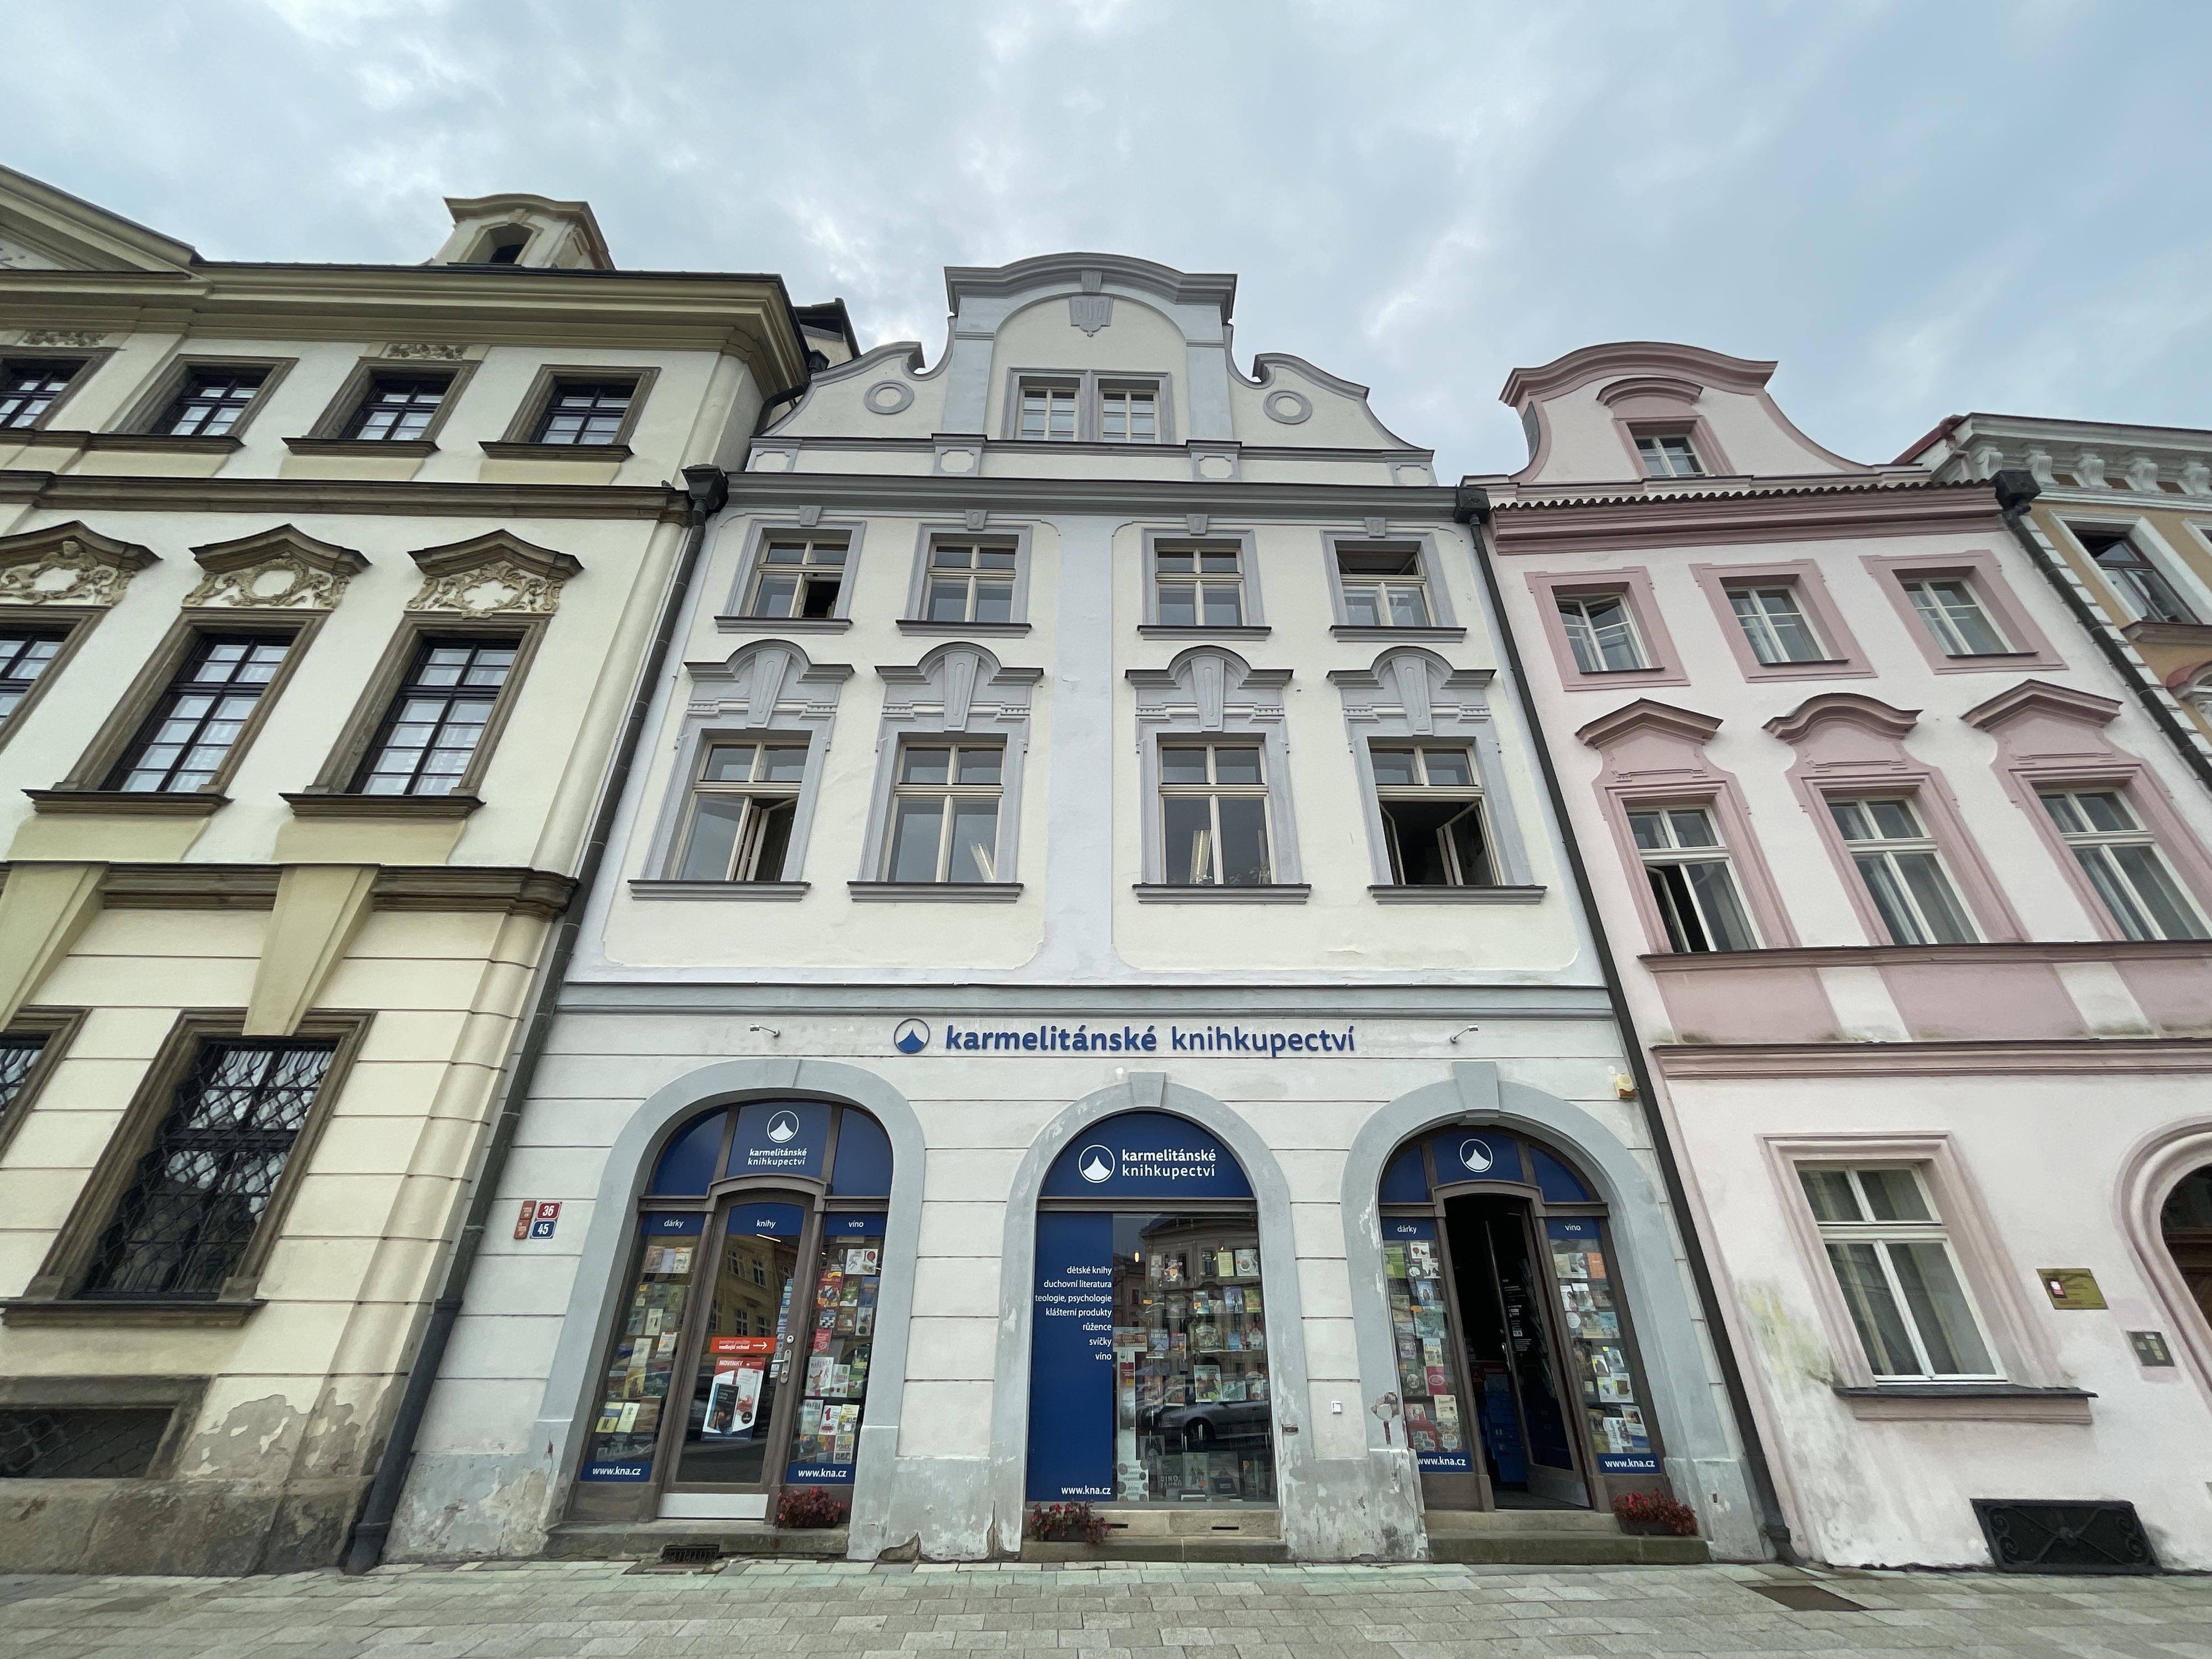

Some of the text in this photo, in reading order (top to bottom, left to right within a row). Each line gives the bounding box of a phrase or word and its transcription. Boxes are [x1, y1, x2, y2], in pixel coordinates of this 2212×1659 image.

[946, 1025, 1354, 1057] karmelitánské knihkupectví
[750, 1147, 806, 1156] karmelitánské
[1123, 1149, 1215, 1161] karmelitánské
[748, 1157, 805, 1167] knihkupectví
[1123, 1164, 1214, 1180] knihkupectví
[542, 1206, 554, 1216] 36
[665, 1220, 684, 1228] dárky
[757, 1220, 775, 1228] knihy
[538, 1224, 549, 1234] 45
[1397, 1225, 1416, 1234] dárky
[1093, 1266, 1112, 1275] knihy
[1035, 1294, 1112, 1303] teologie, psychologie
[1079, 1308, 1112, 1318] produkty
[1089, 1337, 1112, 1347] svíčky
[1418, 1456, 1466, 1466] www.kna.cz
[1605, 1459, 1655, 1467] www.kna.cz
[593, 1466, 641, 1475] www.kna.cz
[799, 1468, 847, 1477] www.kna.cz
[1062, 1485, 1110, 1494] www.kna.cz
